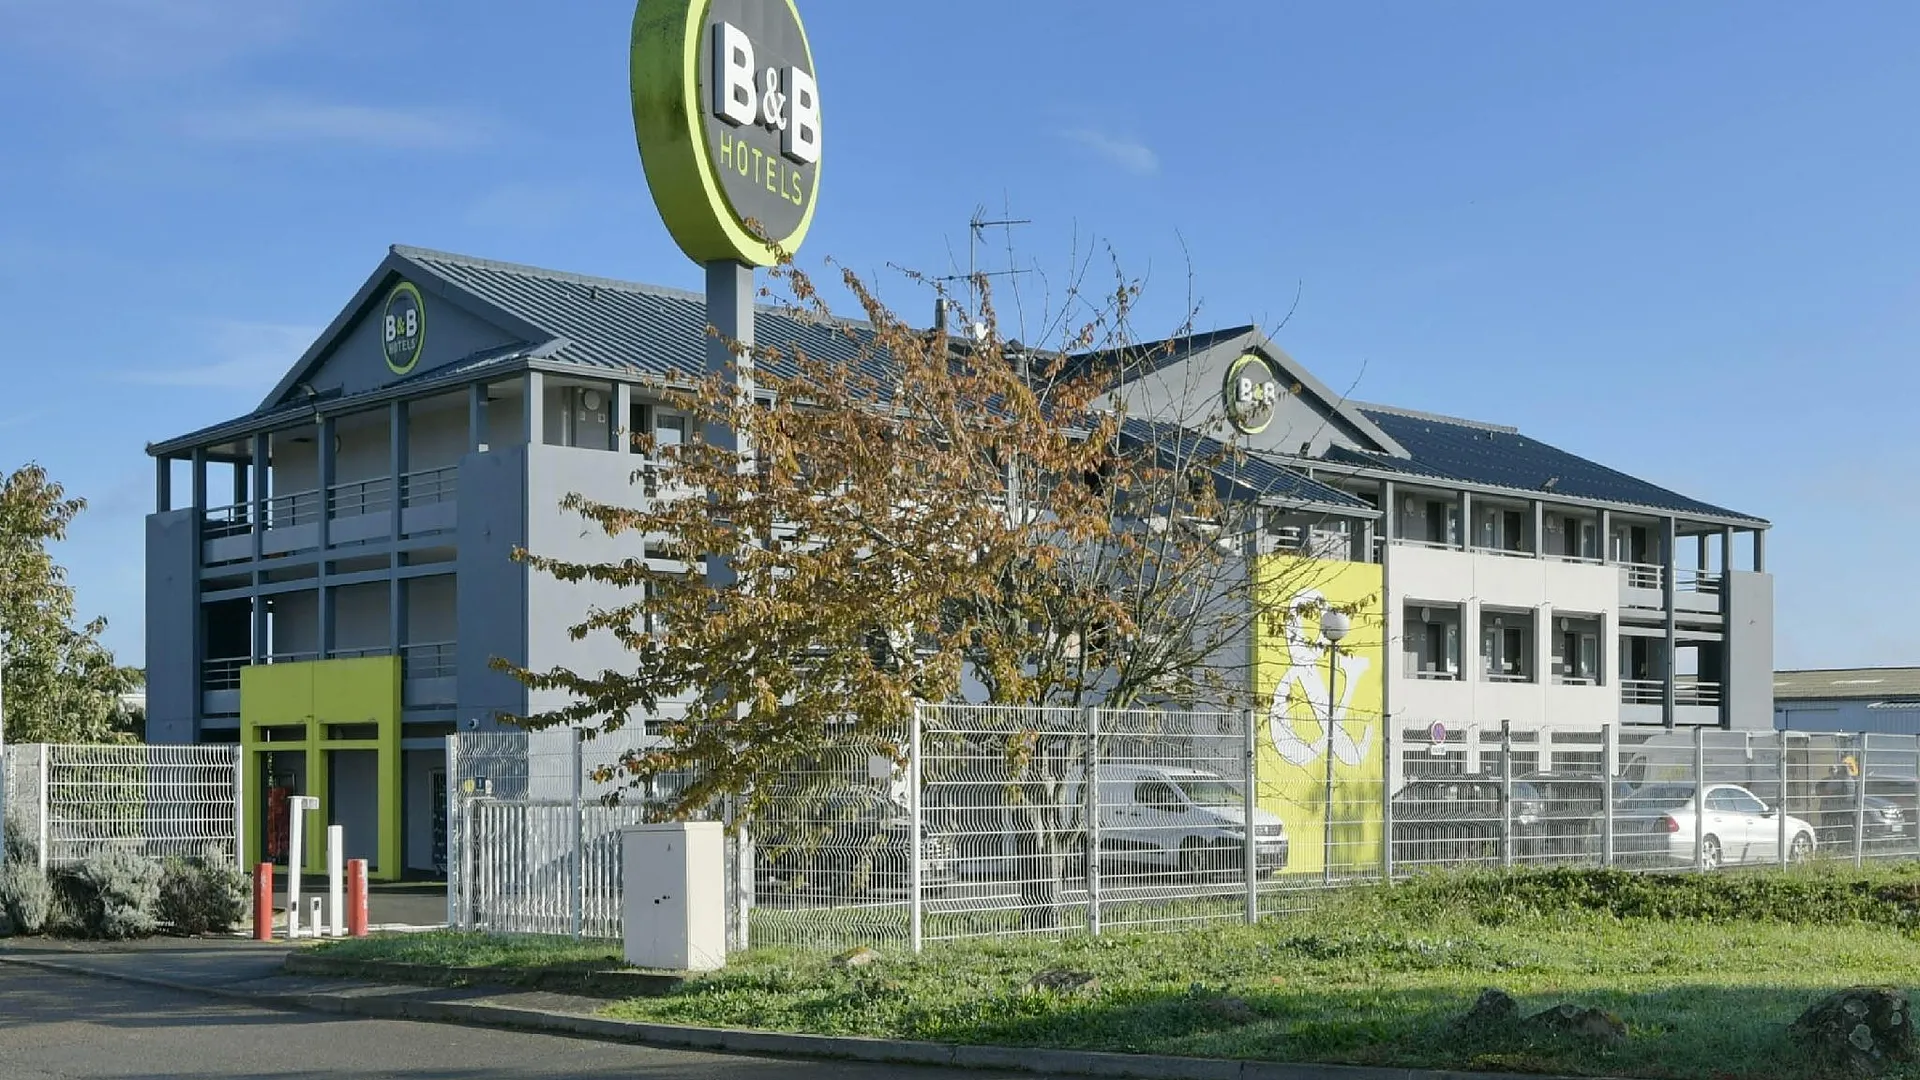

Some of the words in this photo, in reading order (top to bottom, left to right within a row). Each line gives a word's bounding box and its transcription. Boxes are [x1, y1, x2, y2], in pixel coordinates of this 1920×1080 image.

[713, 21, 821, 163] B&B
[720, 129, 802, 205] HOTELS
[386, 309, 417, 342] B&B
